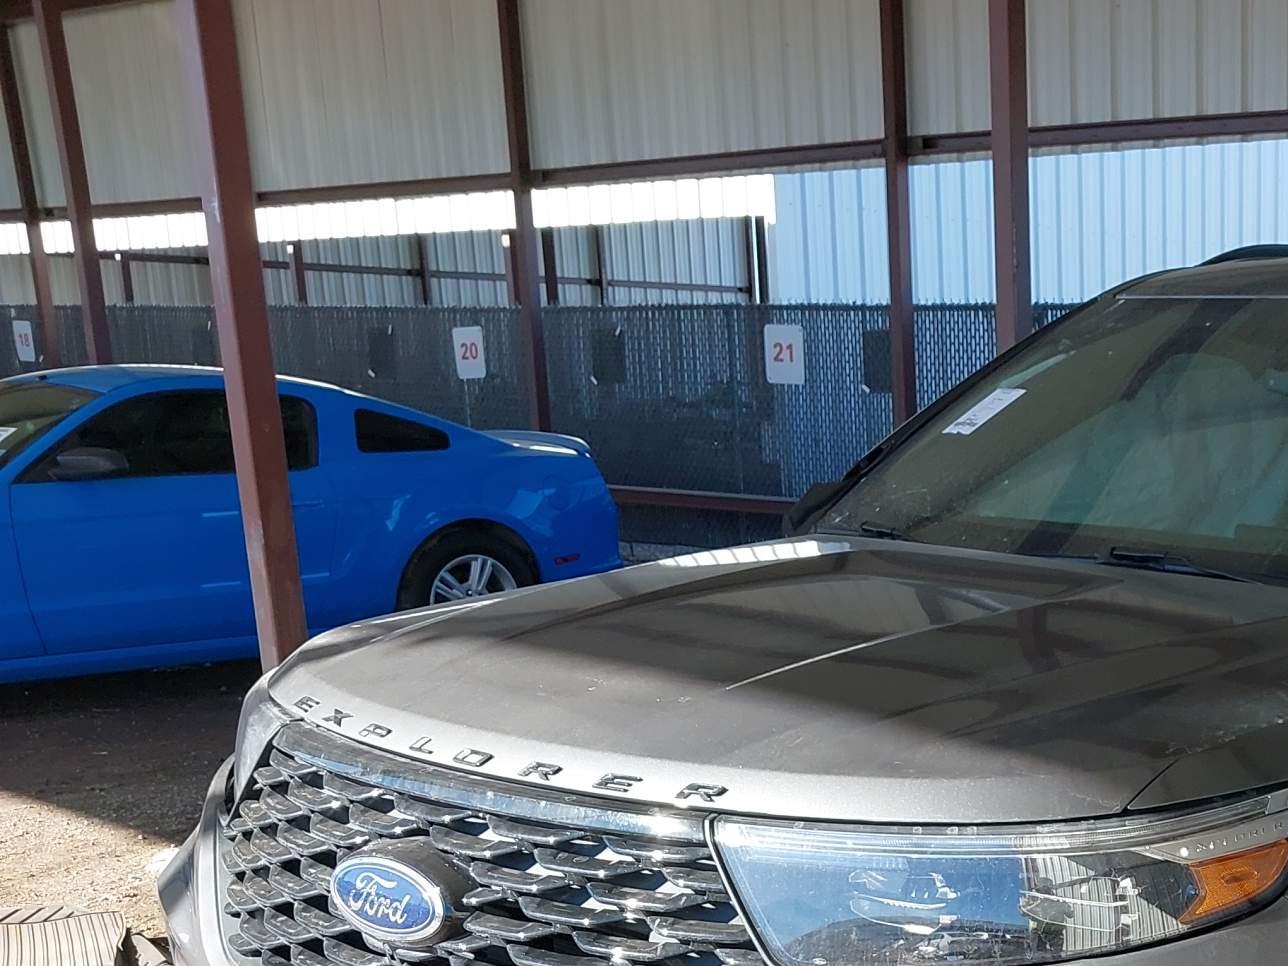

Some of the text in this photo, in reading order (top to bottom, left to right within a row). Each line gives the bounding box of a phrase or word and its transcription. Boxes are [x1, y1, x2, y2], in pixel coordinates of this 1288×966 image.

[460, 341, 479, 361] 20
[773, 342, 794, 363] 21
[293, 694, 729, 802] EXPLORER
[348, 871, 412, 925] Ford
